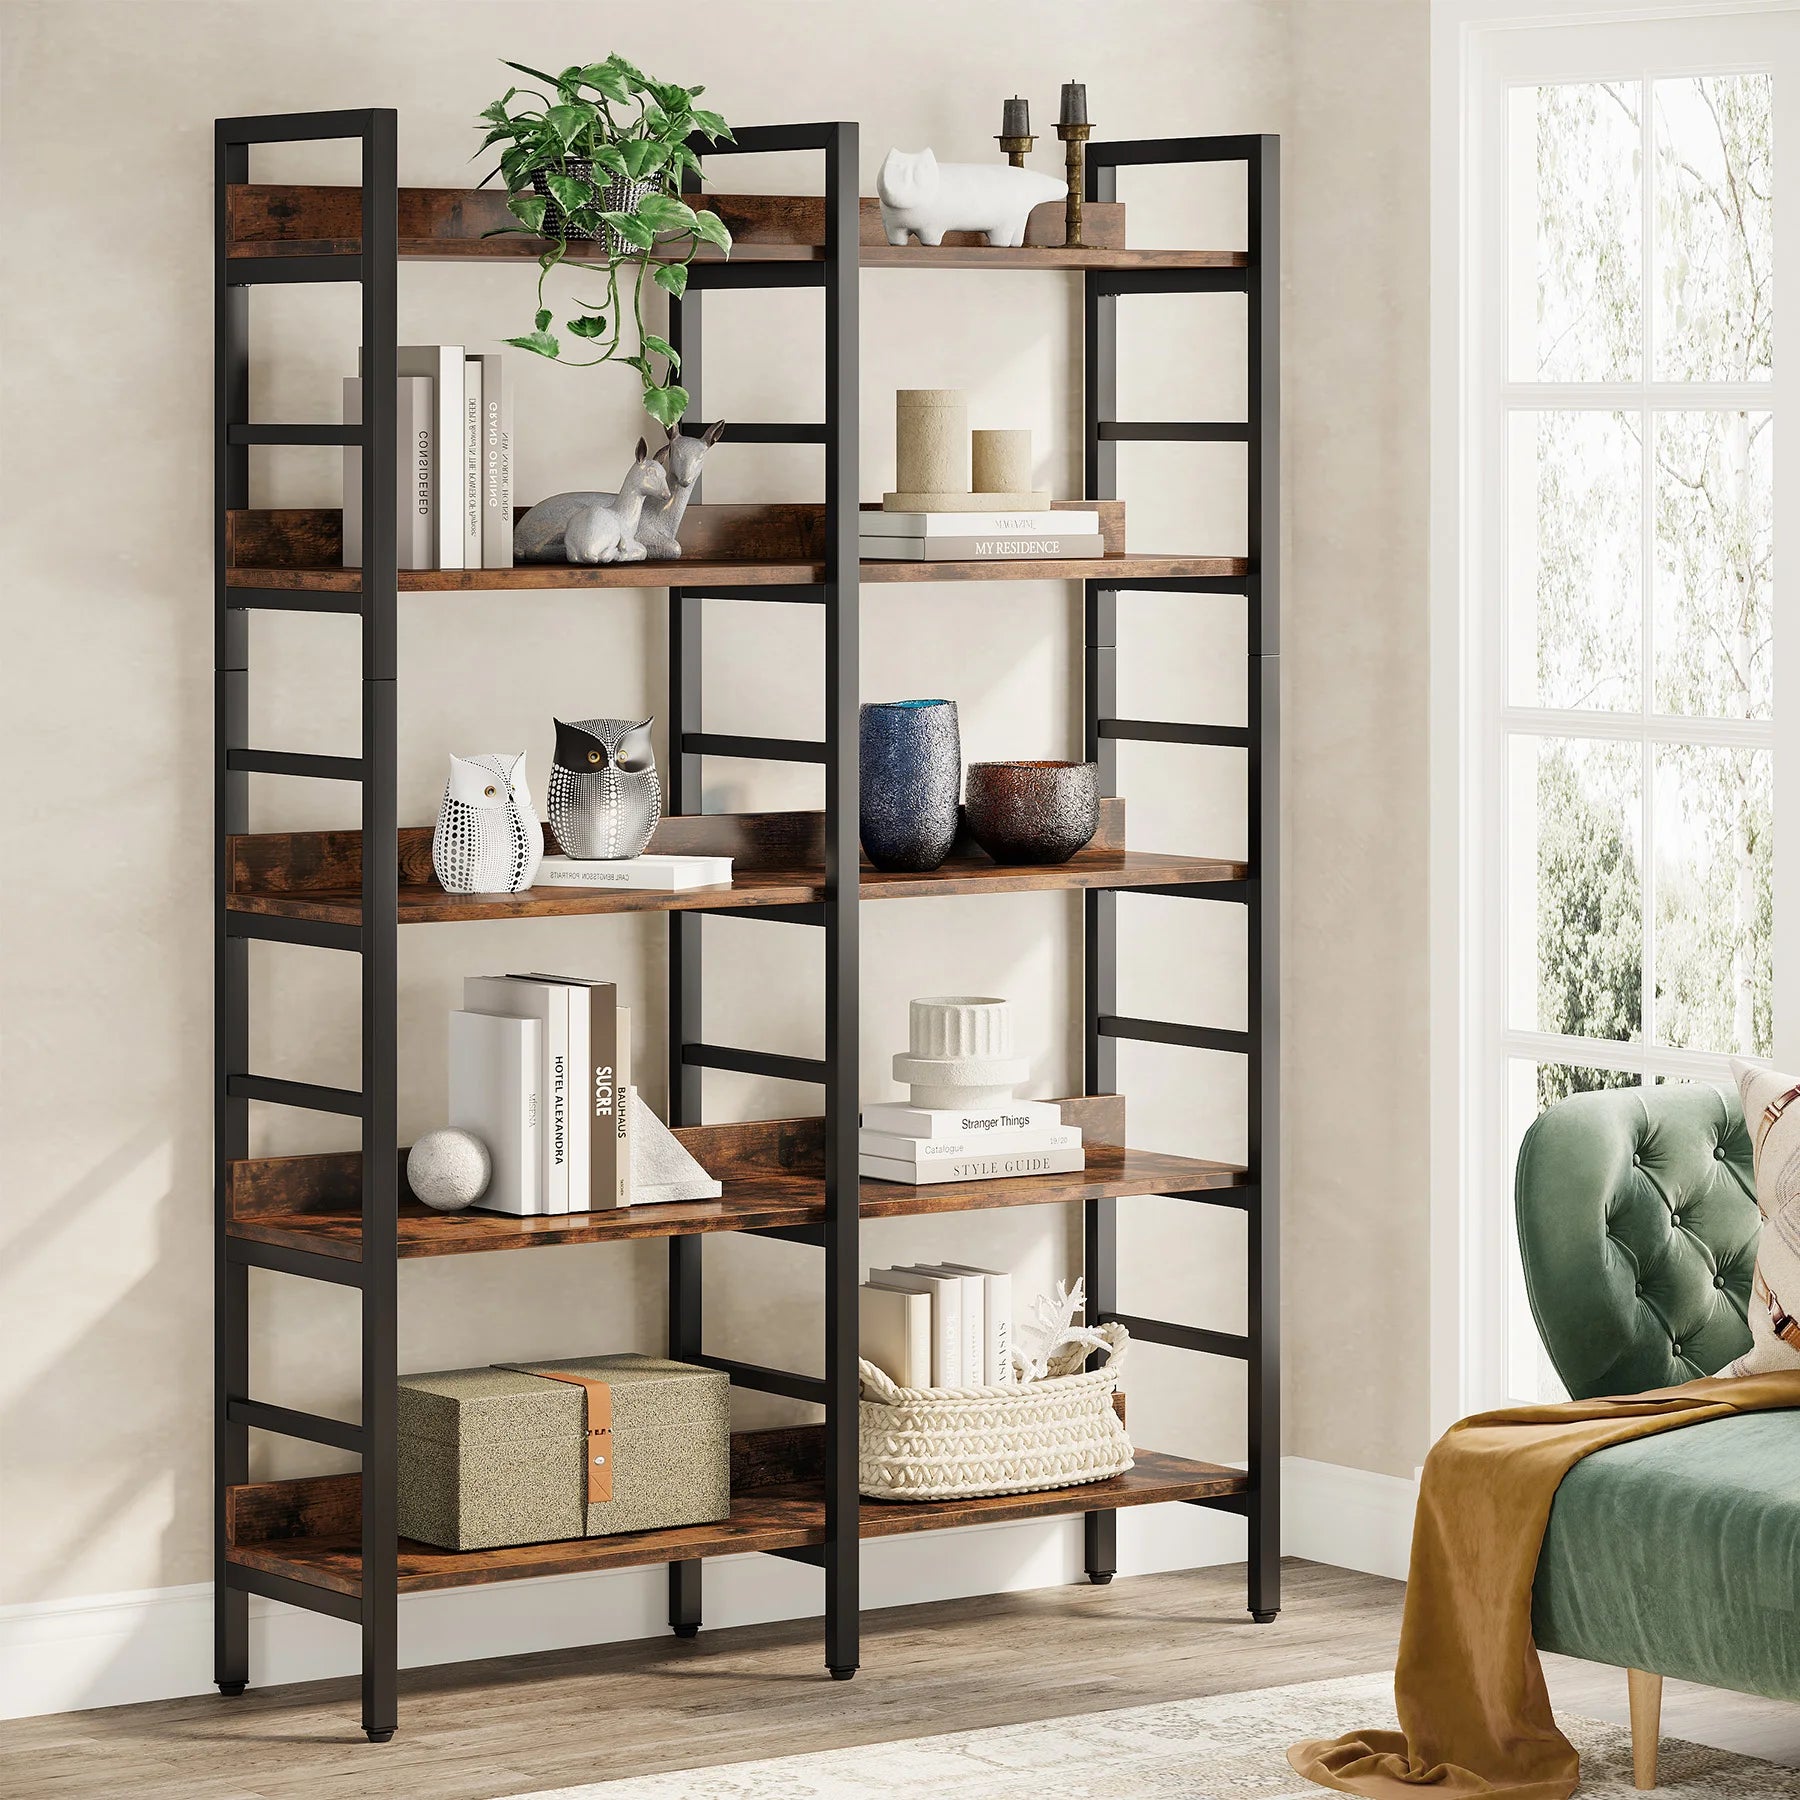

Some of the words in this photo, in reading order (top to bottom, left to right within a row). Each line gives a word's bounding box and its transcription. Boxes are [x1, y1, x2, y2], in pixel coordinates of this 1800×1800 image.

[975, 541, 994, 555] MY
[996, 540, 1061, 554] RESIDENCE
[555, 1055, 564, 1093] HOTEL
[595, 1066, 613, 1117] SUCRE
[617, 1087, 627, 1139] BAUHAUS
[961, 1117, 999, 1131] Stranger
[1000, 1114, 1030, 1129] Things
[555, 1095, 564, 1165] ALEXANDRA
[924, 1143, 964, 1155] Catalogue
[1049, 1136, 1069, 1145] 19/20
[953, 1162, 998, 1177] STYLE
[1005, 1158, 1051, 1173] GUIDE
